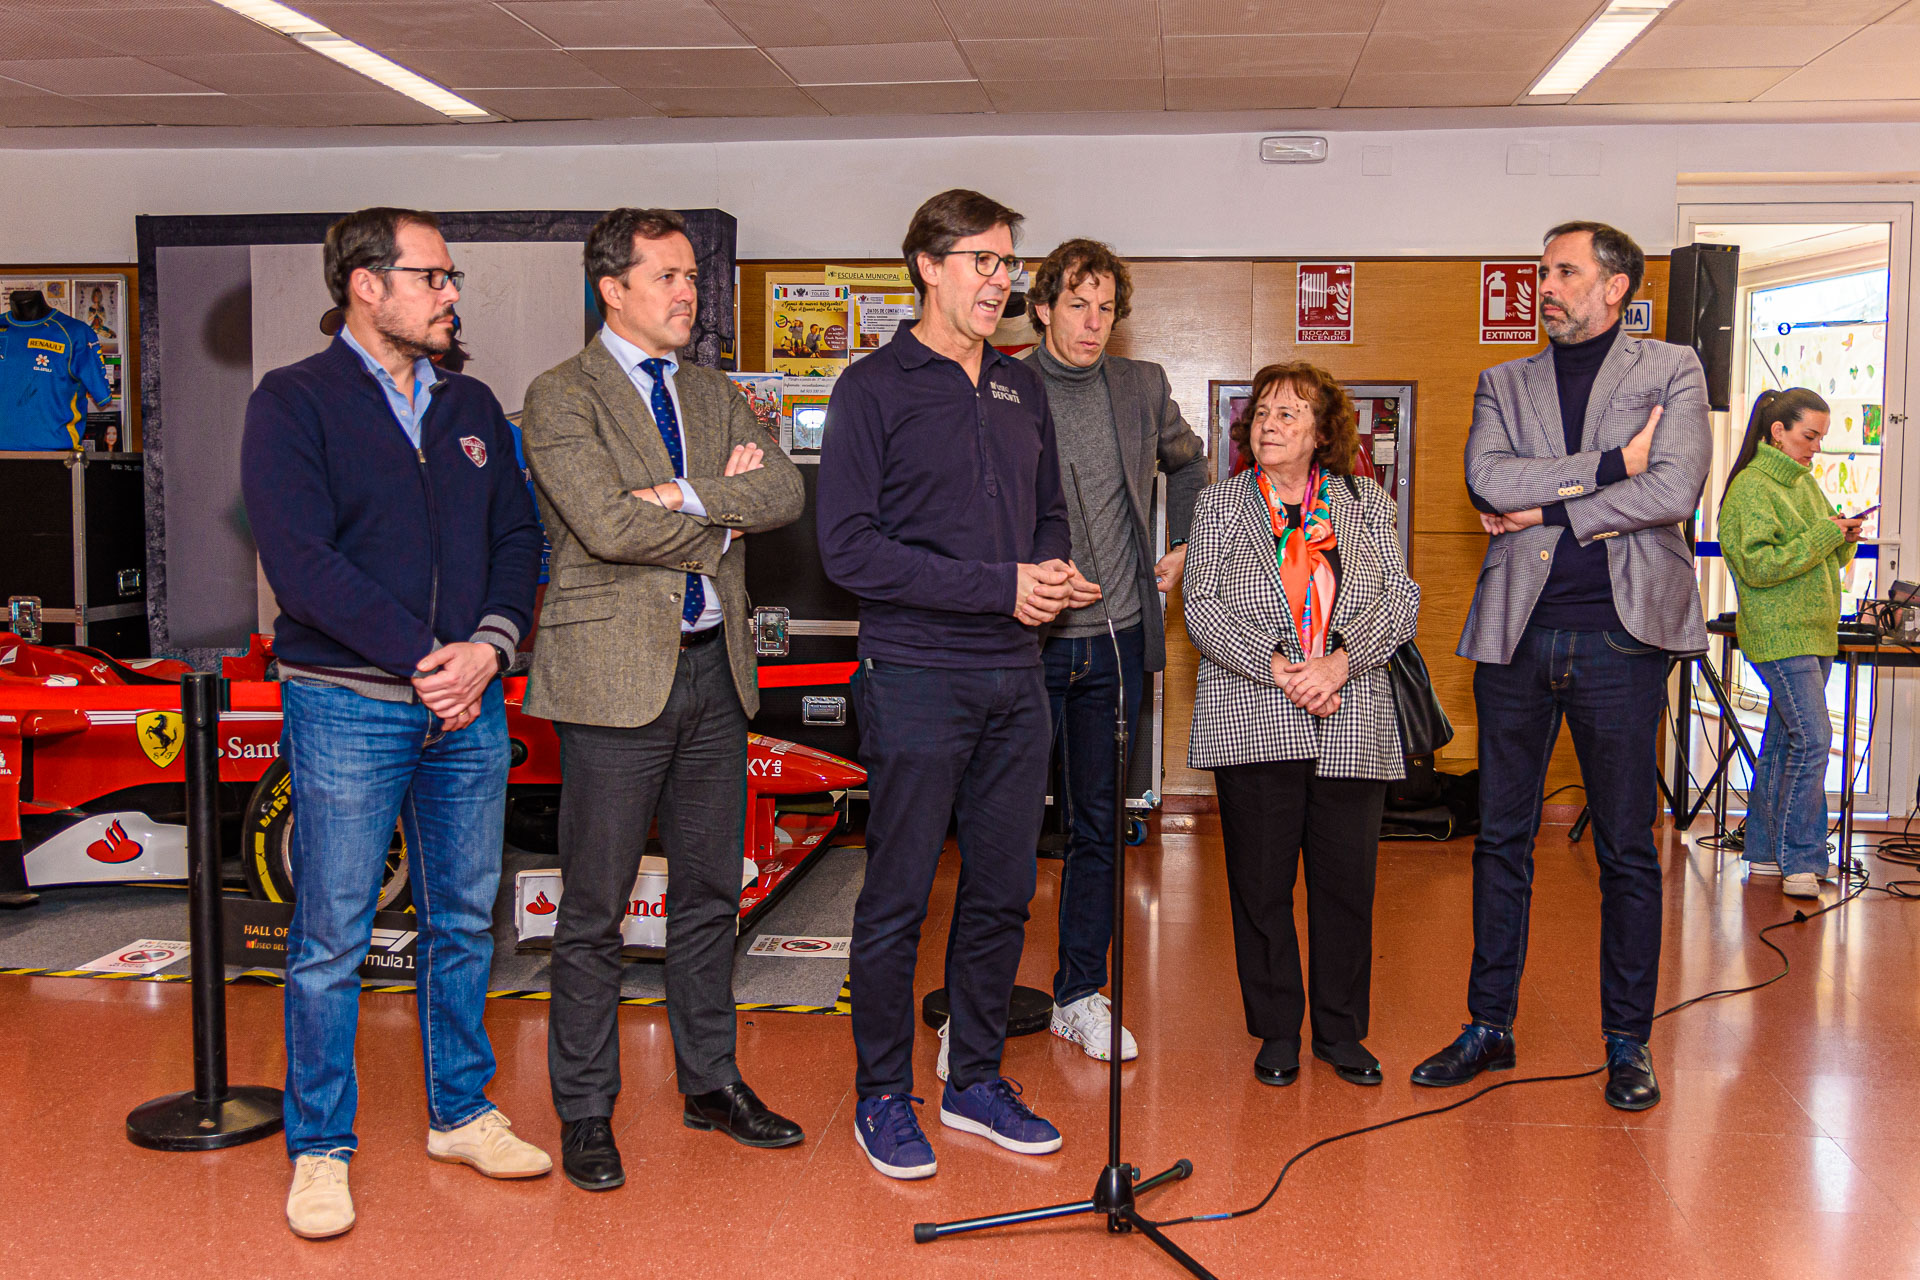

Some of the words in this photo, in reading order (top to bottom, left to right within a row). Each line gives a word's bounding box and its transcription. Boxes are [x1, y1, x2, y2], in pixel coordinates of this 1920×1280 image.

[865, 272, 900, 280] MUNICIPAL
[1485, 331, 1532, 340] EXTINTOR
[29, 340, 62, 351] RENAULT
[228, 736, 280, 759] Sant
[771, 759, 782, 777] lab
[243, 924, 271, 936] HALL
[273, 927, 289, 938] OF
[245, 938, 272, 950] MUSEO
[273, 943, 285, 951] DEL
[364, 953, 403, 968] mula
[405, 955, 415, 969] 1
